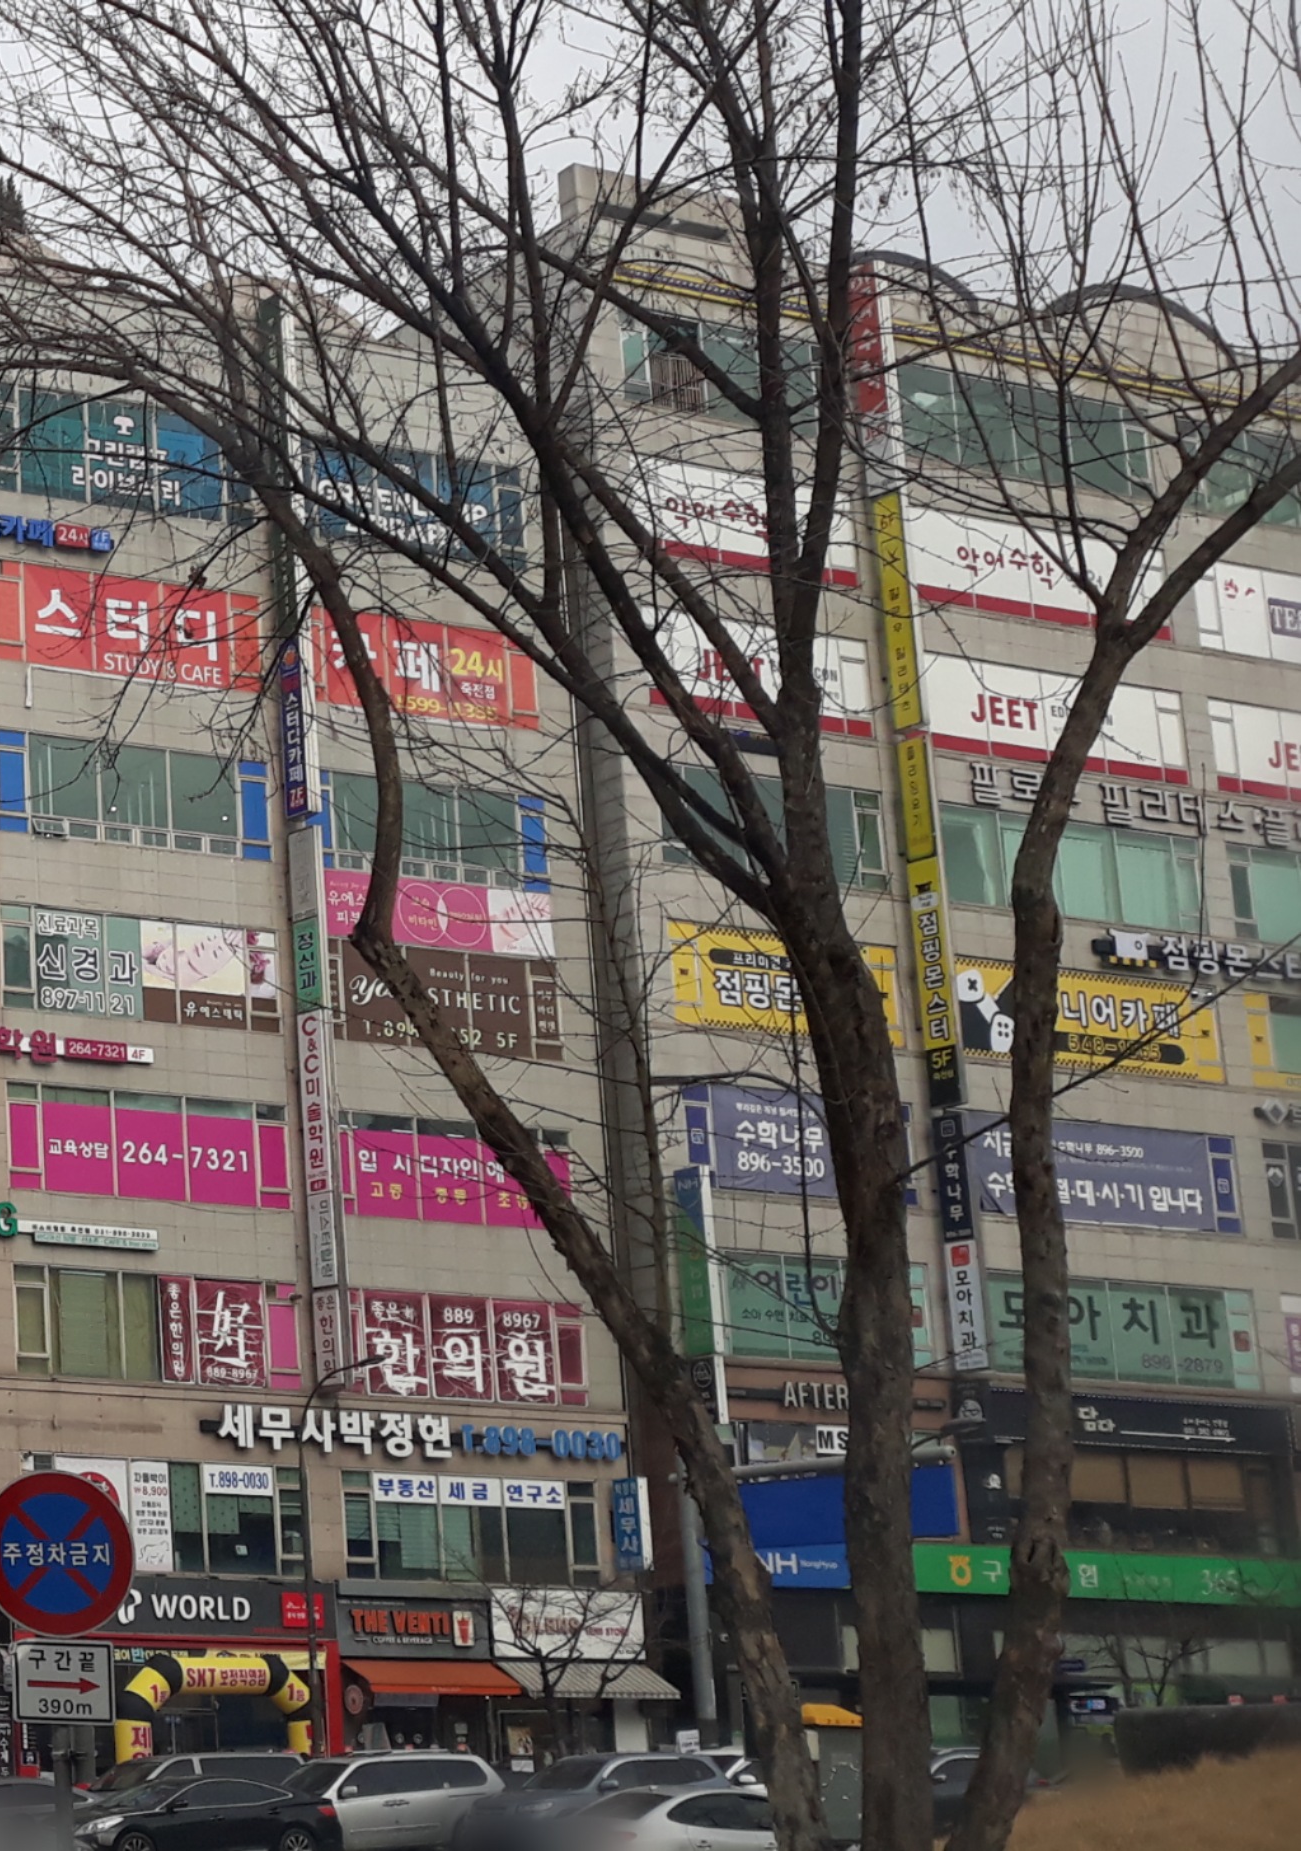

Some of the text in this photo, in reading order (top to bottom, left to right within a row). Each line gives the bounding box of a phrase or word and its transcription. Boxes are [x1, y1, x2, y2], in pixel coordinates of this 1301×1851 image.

[58, 525, 89, 547] 24시
[956, 545, 1056, 591] 악어수학
[34, 588, 218, 662] 스터디
[103, 652, 160, 677] STUDY
[180, 662, 223, 685] CAFE
[450, 648, 504, 684] 24시
[459, 680, 496, 700] 죽전점
[970, 692, 1040, 732] JEET
[285, 692, 305, 785] 스터디카페
[36, 913, 100, 939] 진료과목
[37, 943, 139, 986] 신경과
[298, 931, 317, 991] 정신과
[429, 967, 509, 986] Beauty for you
[917, 911, 951, 1041] 점핑몬스터
[40, 986, 136, 1016] 897-1121
[68, 1041, 125, 1060] 264-7321
[131, 1049, 146, 1060] 4F
[496, 1031, 519, 1049] 5F
[931, 1050, 953, 1069] 5F
[300, 1014, 328, 1171] C&C미술학원
[735, 1119, 825, 1153] 수학나무
[1096, 1142, 1144, 1159] 896-3500
[48, 1139, 249, 1172] 교육상담 264-7321
[737, 1151, 826, 1178] 896-3500
[1150, 1186, 1203, 1214] 입니다
[754, 1270, 839, 1307] 어린이
[443, 1306, 541, 1328] 889 8967
[954, 1270, 979, 1351] 모아치과
[784, 1381, 848, 1411] AFTER
[208, 1470, 269, 1492] T.898-0030
[378, 1477, 563, 1505] 부동산 세금 연구소
[1, 1541, 113, 1569] 주정차금지
[150, 1593, 251, 1622] WORLD
[351, 1608, 388, 1634] THE
[393, 1609, 450, 1636] VENTI
[38, 1698, 93, 1716] 390m
